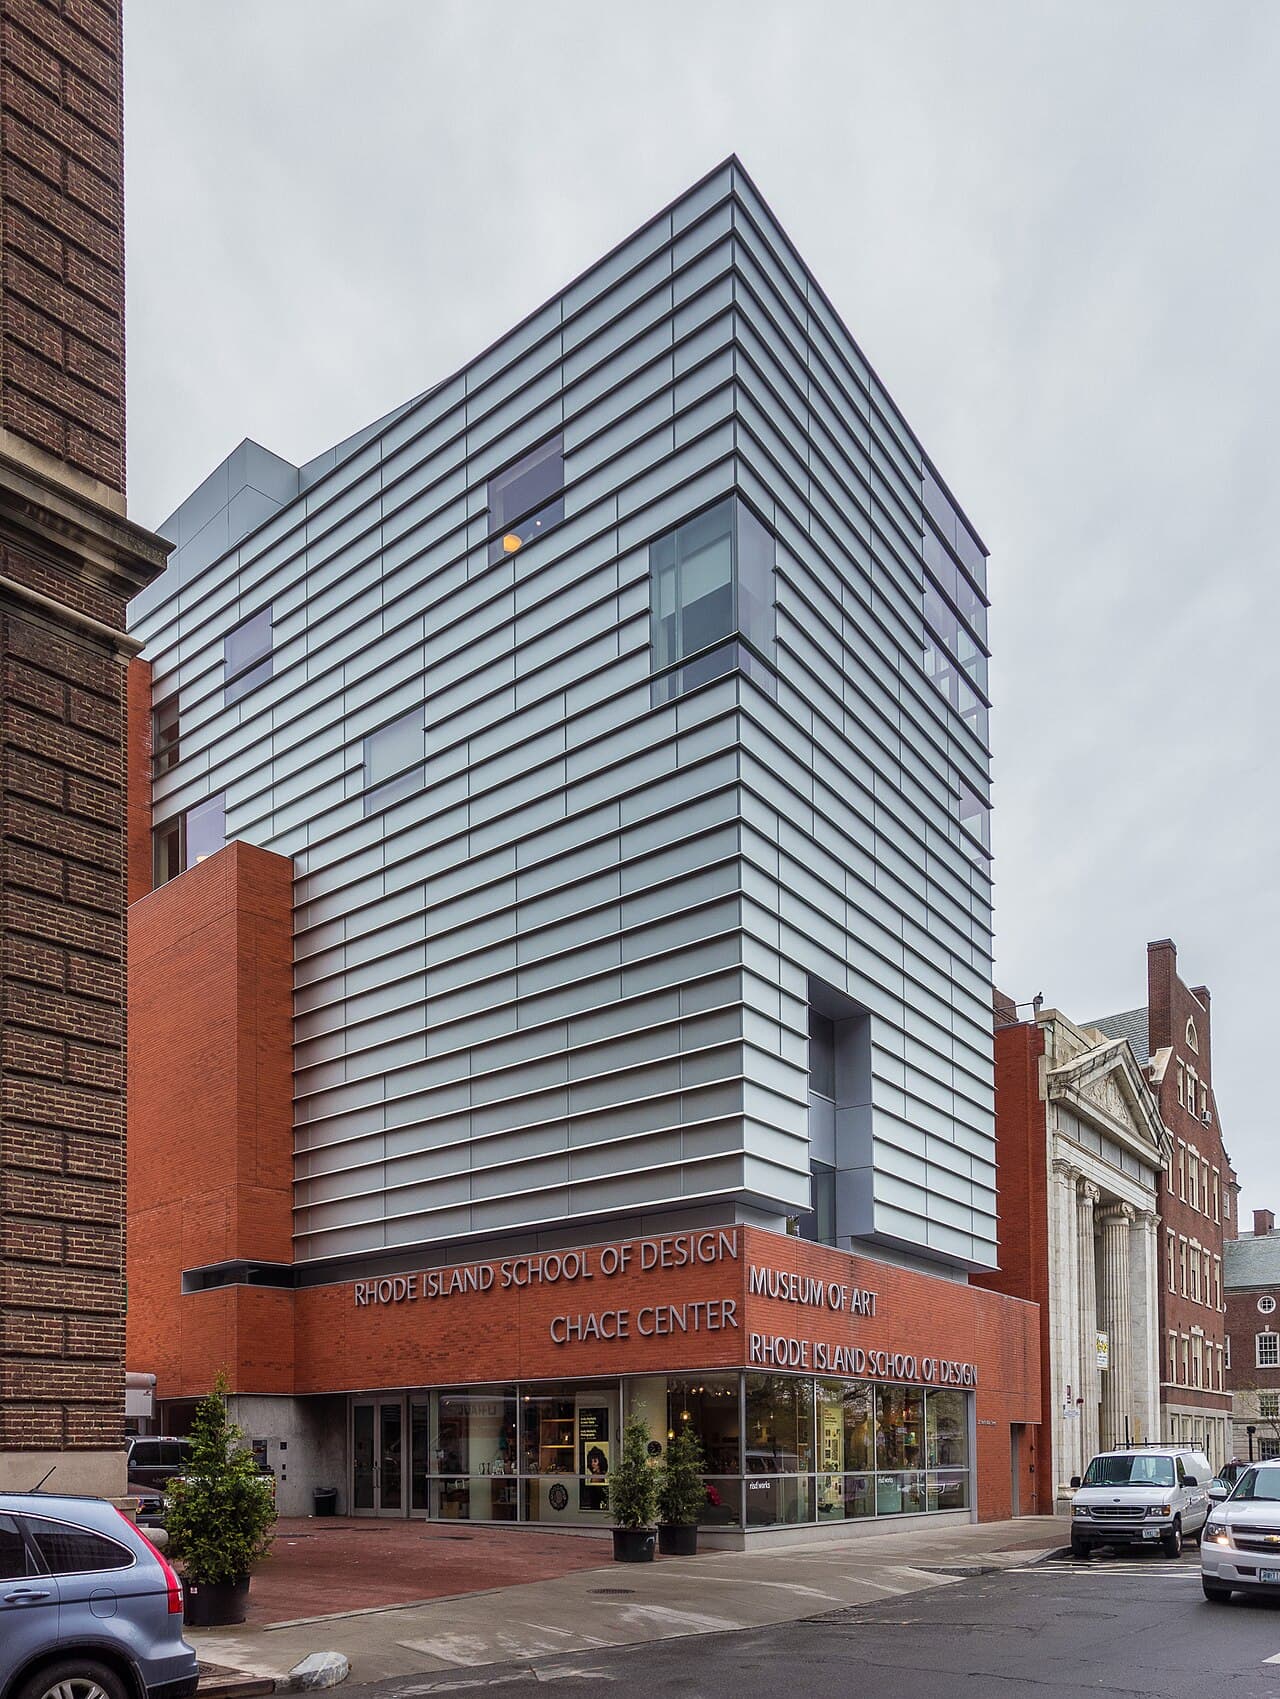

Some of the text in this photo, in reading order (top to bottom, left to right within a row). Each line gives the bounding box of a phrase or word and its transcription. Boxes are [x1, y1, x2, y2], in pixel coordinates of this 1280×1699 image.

[354, 1229, 738, 1306] RHODE ISLAND SCHOOL OF DESIGN
[749, 1264, 878, 1317] MUSEUM OF ART
[550, 1299, 738, 1343] CHACE CENTER
[749, 1332, 978, 1386] RHODE ISLAND SCHOOL OF DESIGN
